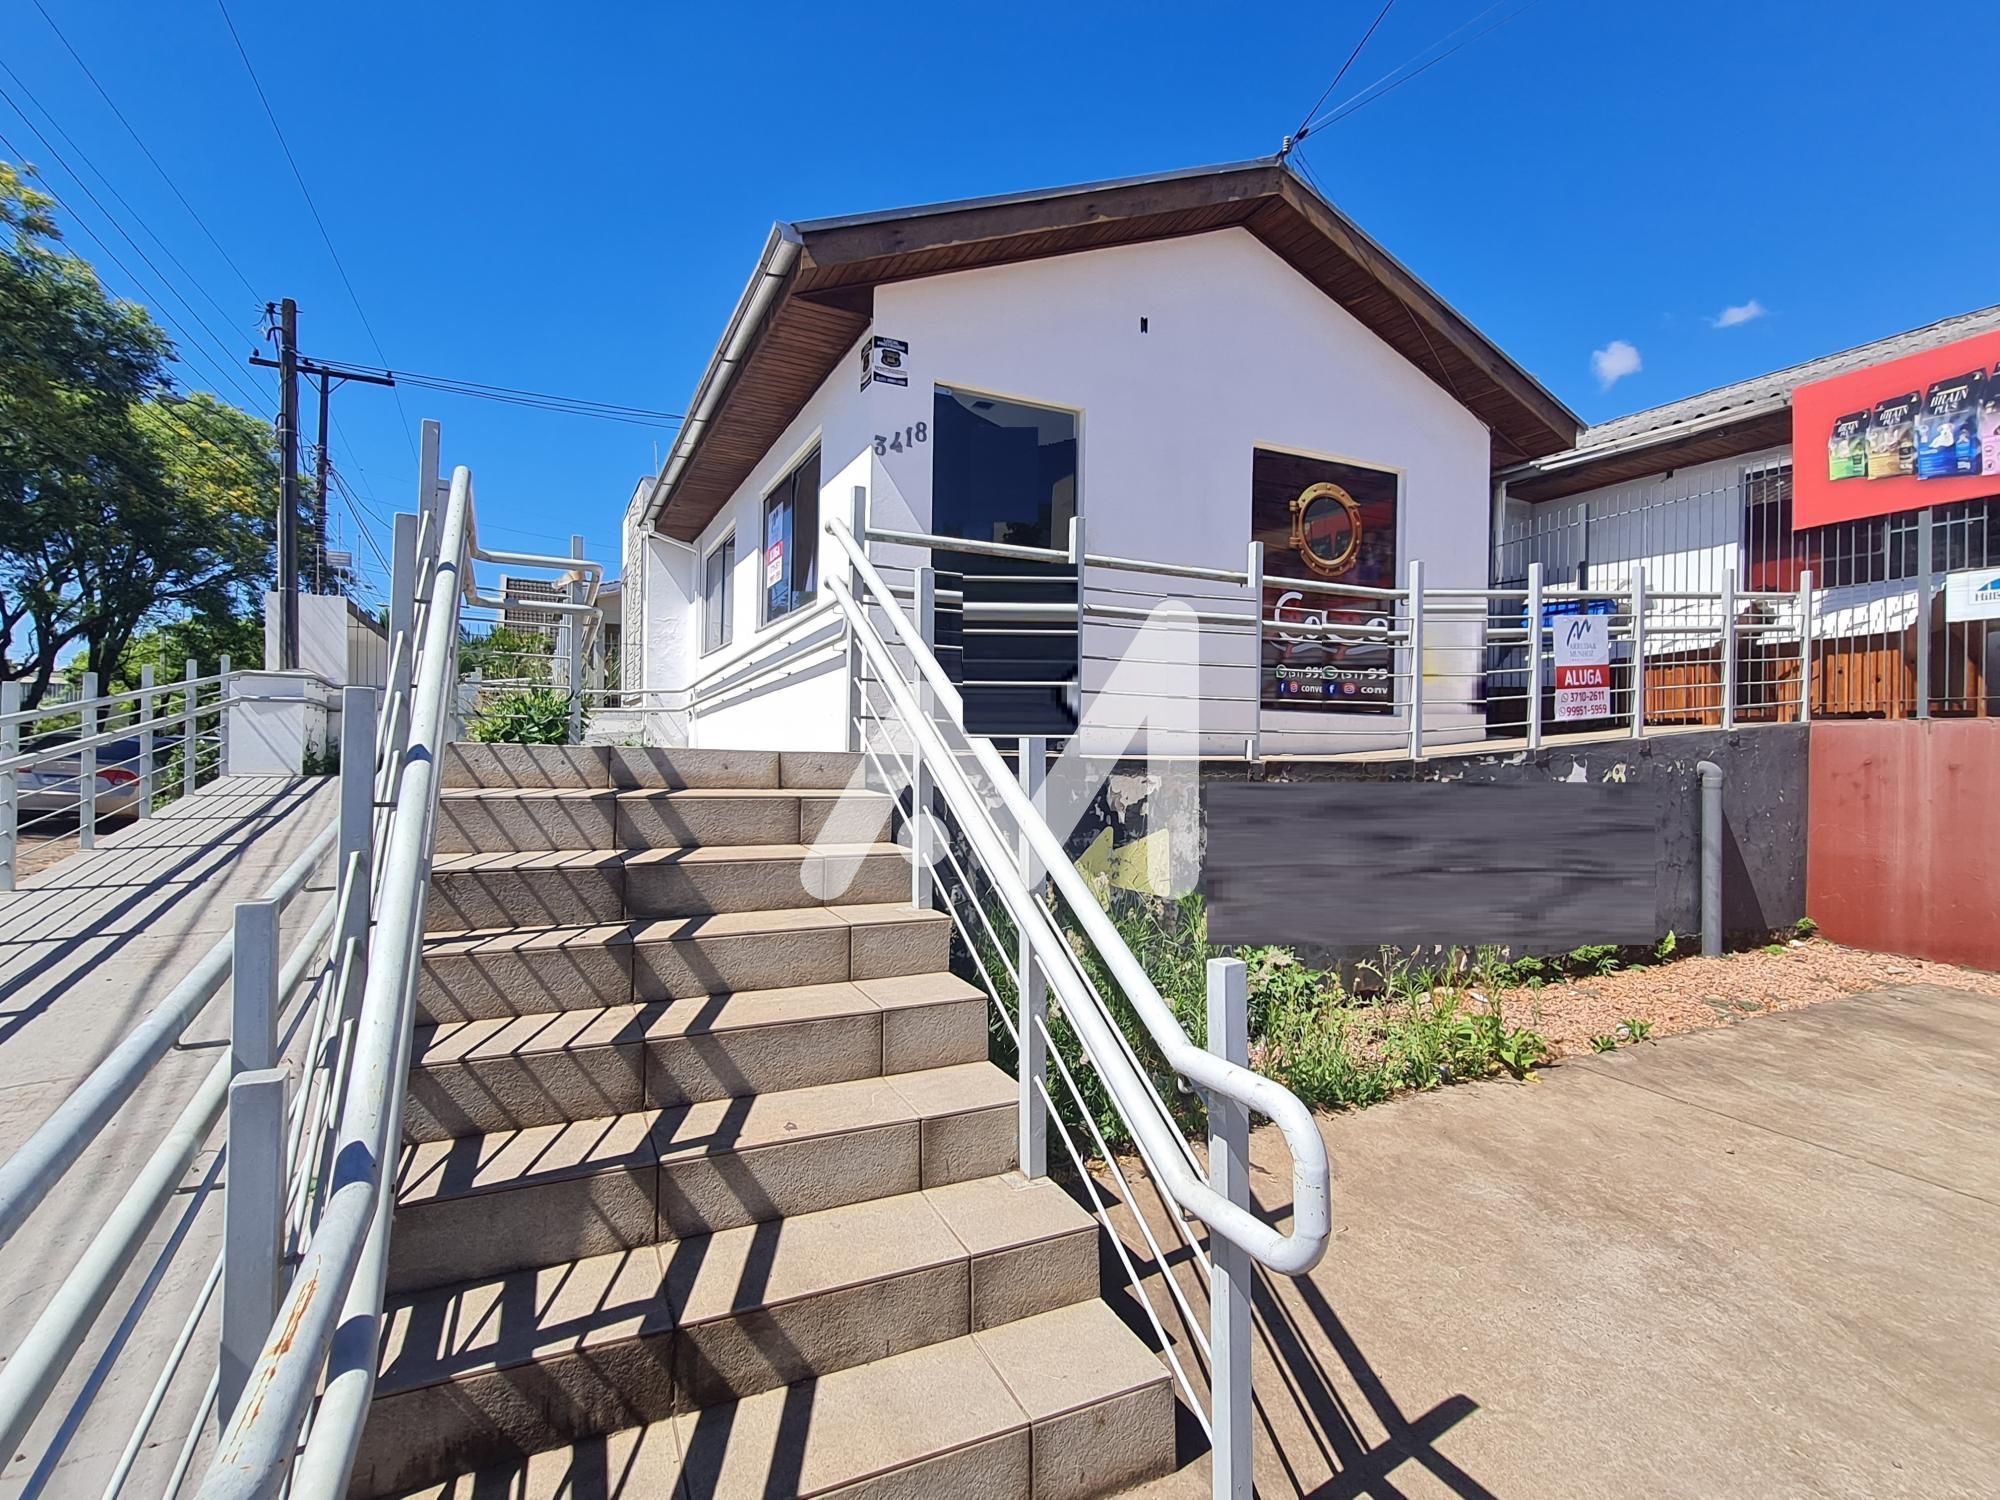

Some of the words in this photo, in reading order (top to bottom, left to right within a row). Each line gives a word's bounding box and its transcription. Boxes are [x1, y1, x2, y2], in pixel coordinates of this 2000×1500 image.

[874, 421, 928, 456] 3418
[1564, 669, 1603, 687] ALUGA
[1570, 690, 1605, 702] 3710-2611
